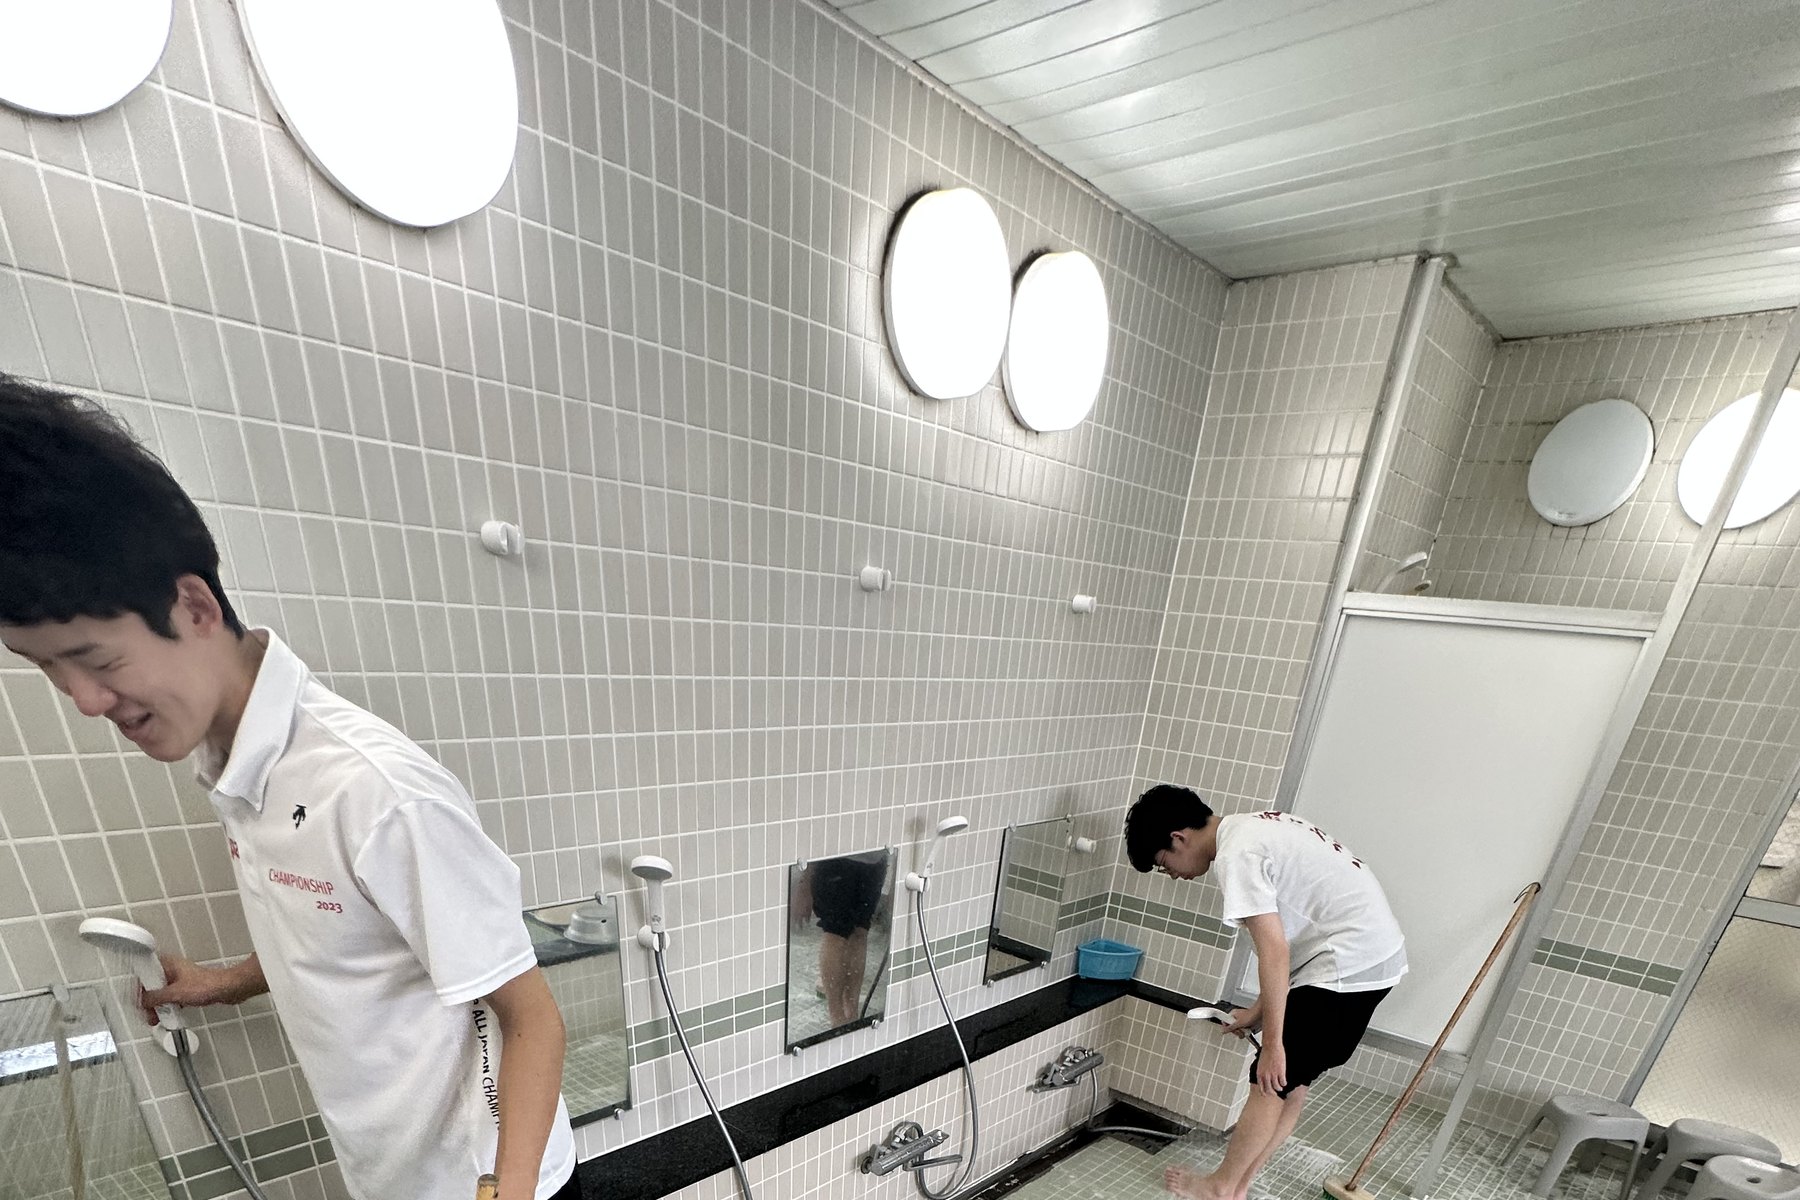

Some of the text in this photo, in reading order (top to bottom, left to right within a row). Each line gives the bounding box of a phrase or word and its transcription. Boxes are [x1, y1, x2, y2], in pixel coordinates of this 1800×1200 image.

[268, 868, 334, 895] CHAMPIONSHIP
[316, 900, 343, 914] 2023
[472, 1010, 487, 1033] ALL
